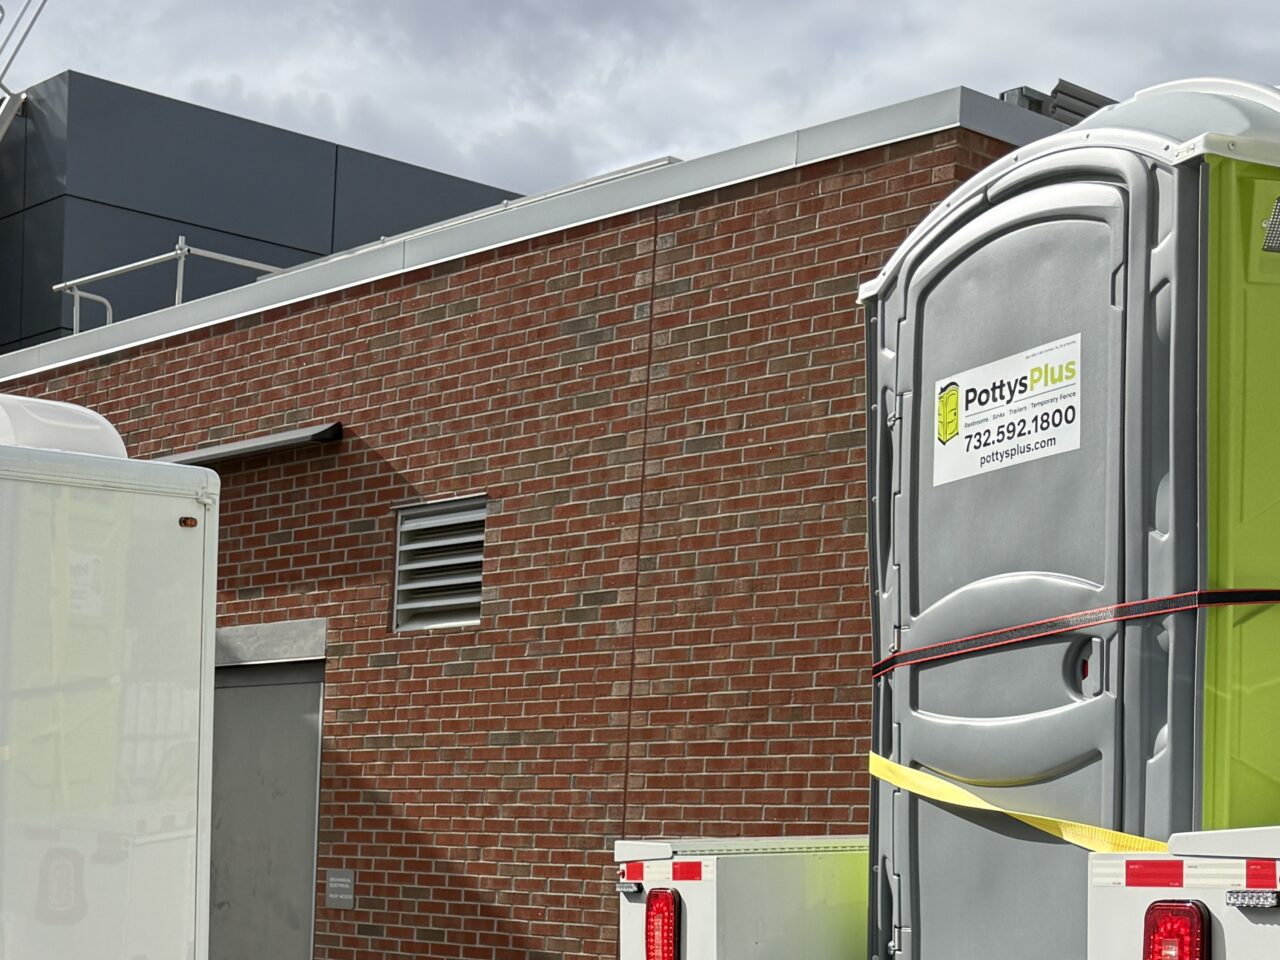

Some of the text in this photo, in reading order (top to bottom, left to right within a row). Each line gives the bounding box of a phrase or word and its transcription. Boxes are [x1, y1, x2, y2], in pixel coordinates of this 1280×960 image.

[964, 360, 1077, 412] PottysPlus
[1031, 397, 1058, 410] Temporary
[1059, 391, 1077, 401] Fence
[964, 404, 1077, 453] 732.592.1800
[979, 437, 1057, 468] pottysplus.com
